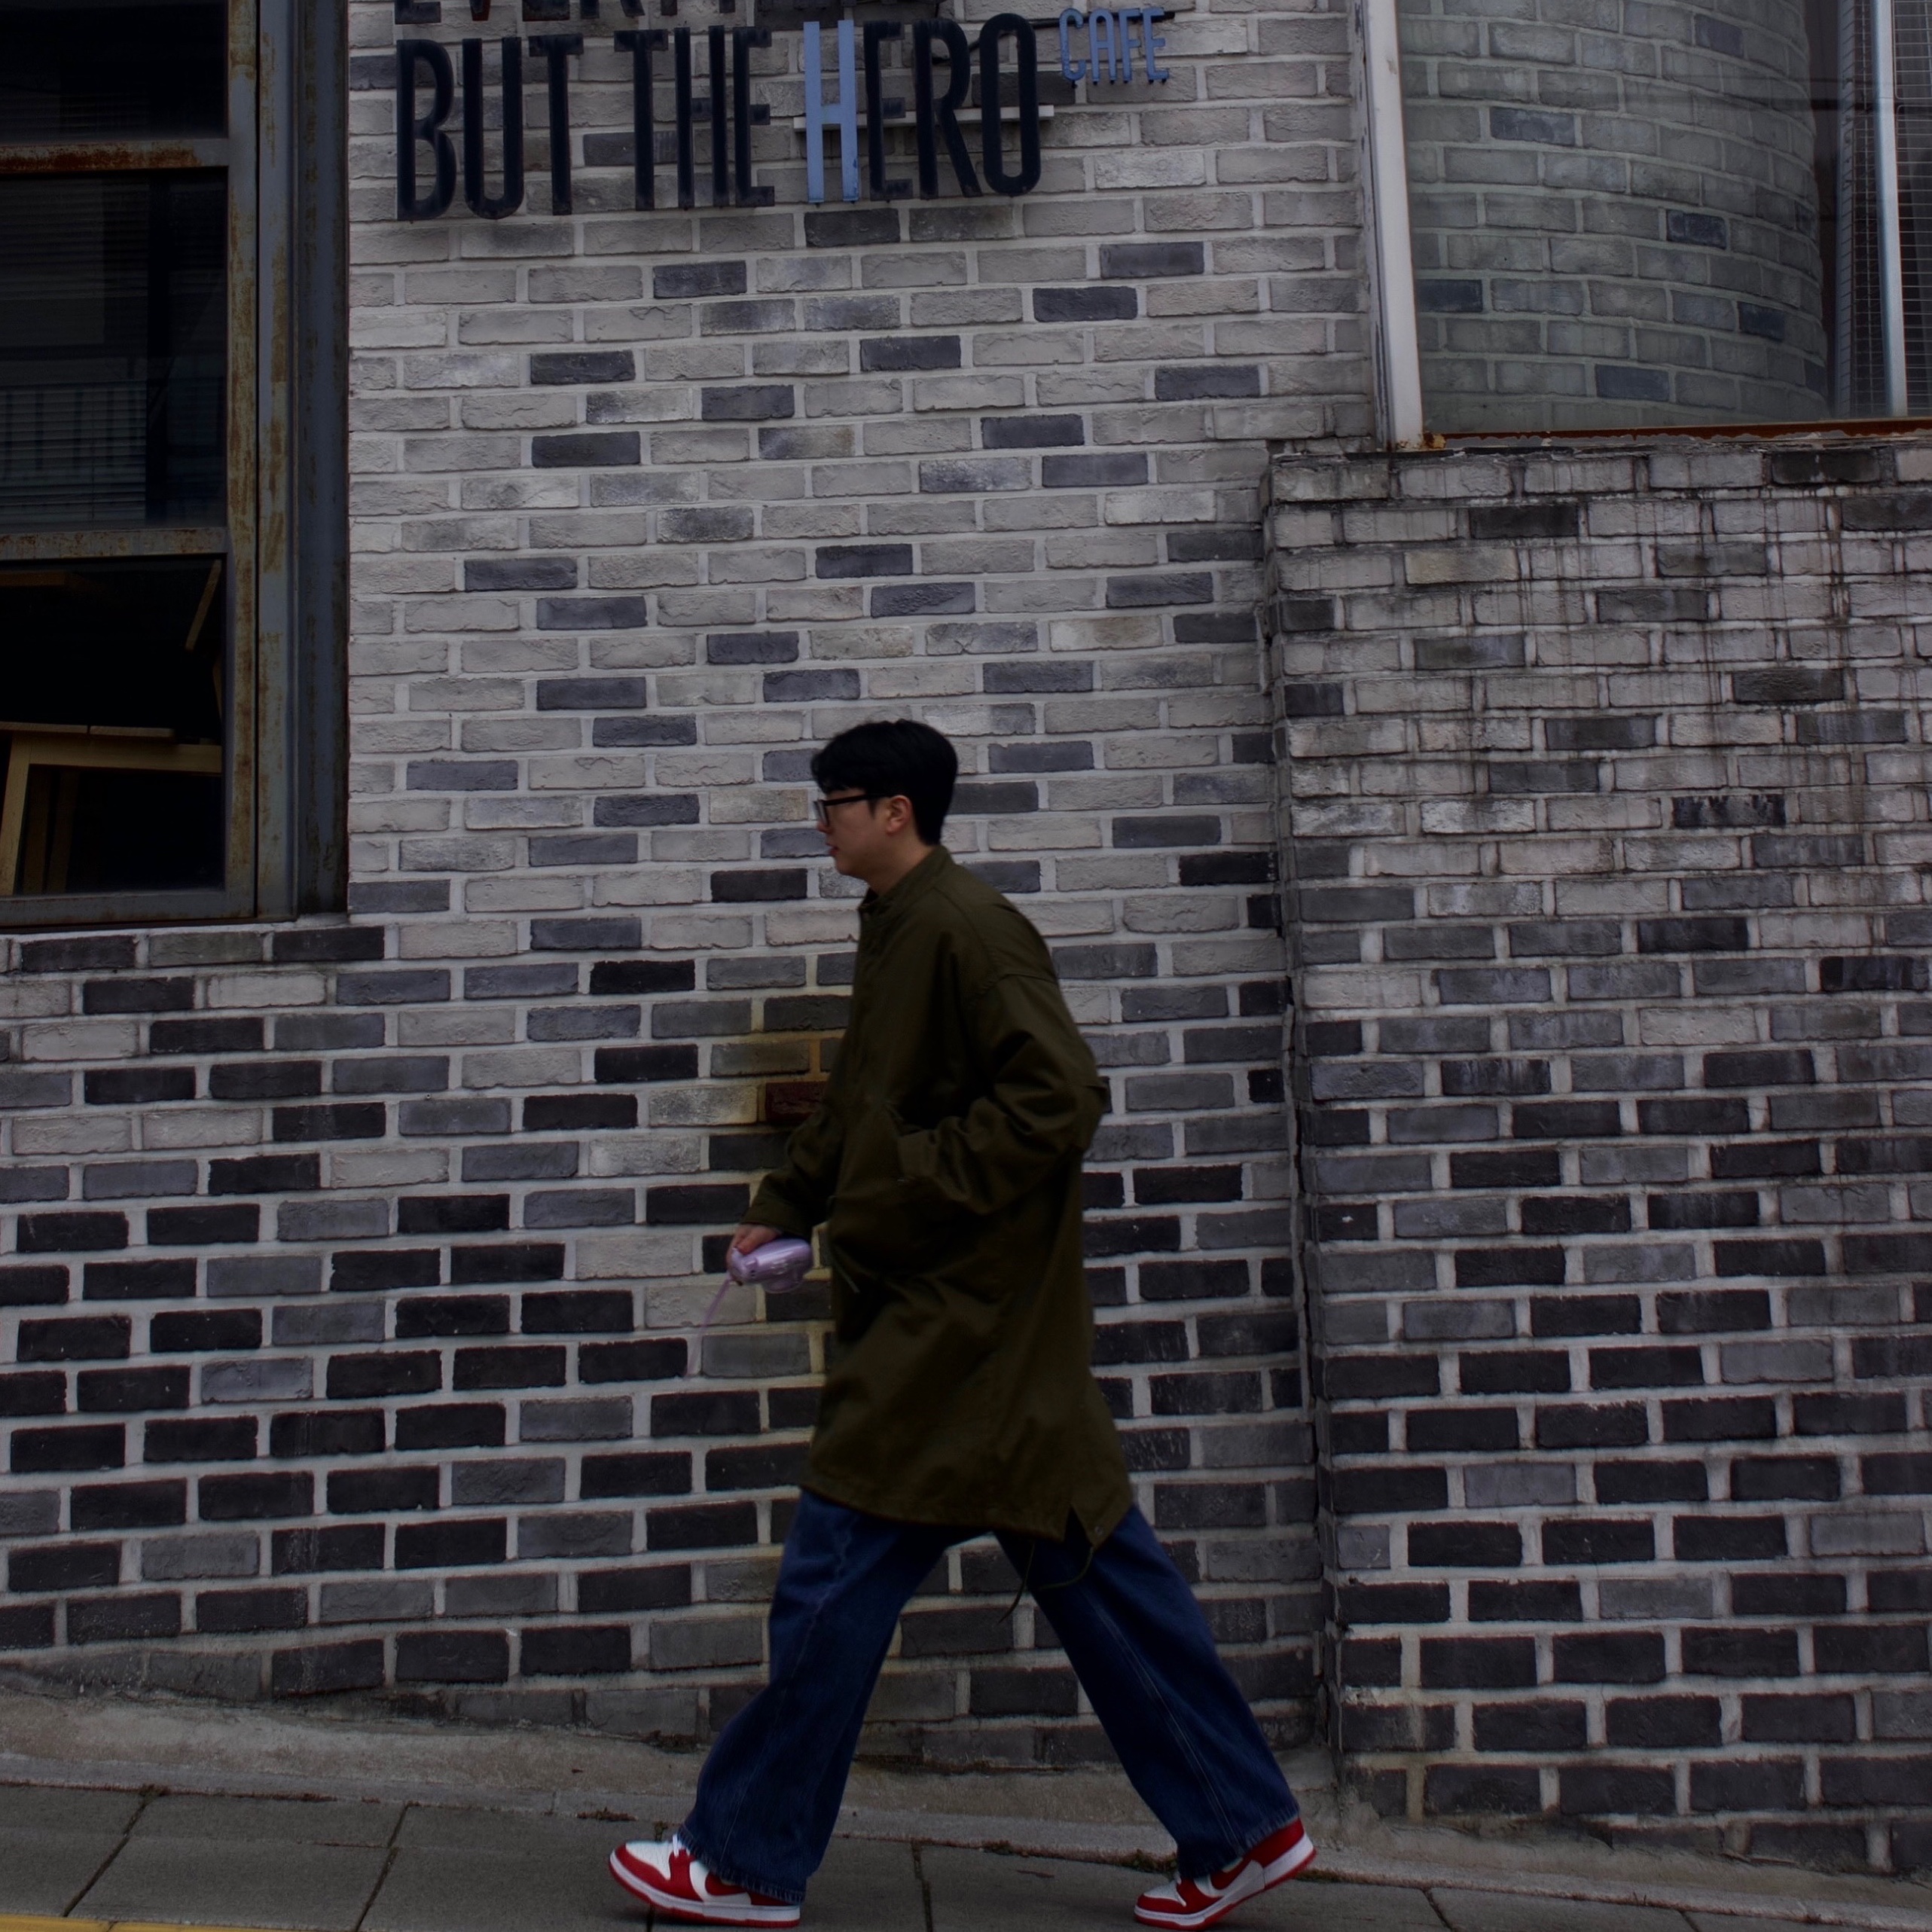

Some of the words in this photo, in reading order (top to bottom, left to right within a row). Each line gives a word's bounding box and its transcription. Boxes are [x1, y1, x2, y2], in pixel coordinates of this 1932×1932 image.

[1059, 7, 1170, 82] CAFE
[396, 33, 584, 221] BUT
[614, 25, 774, 211] THE
[803, 13, 1041, 204] HERO
